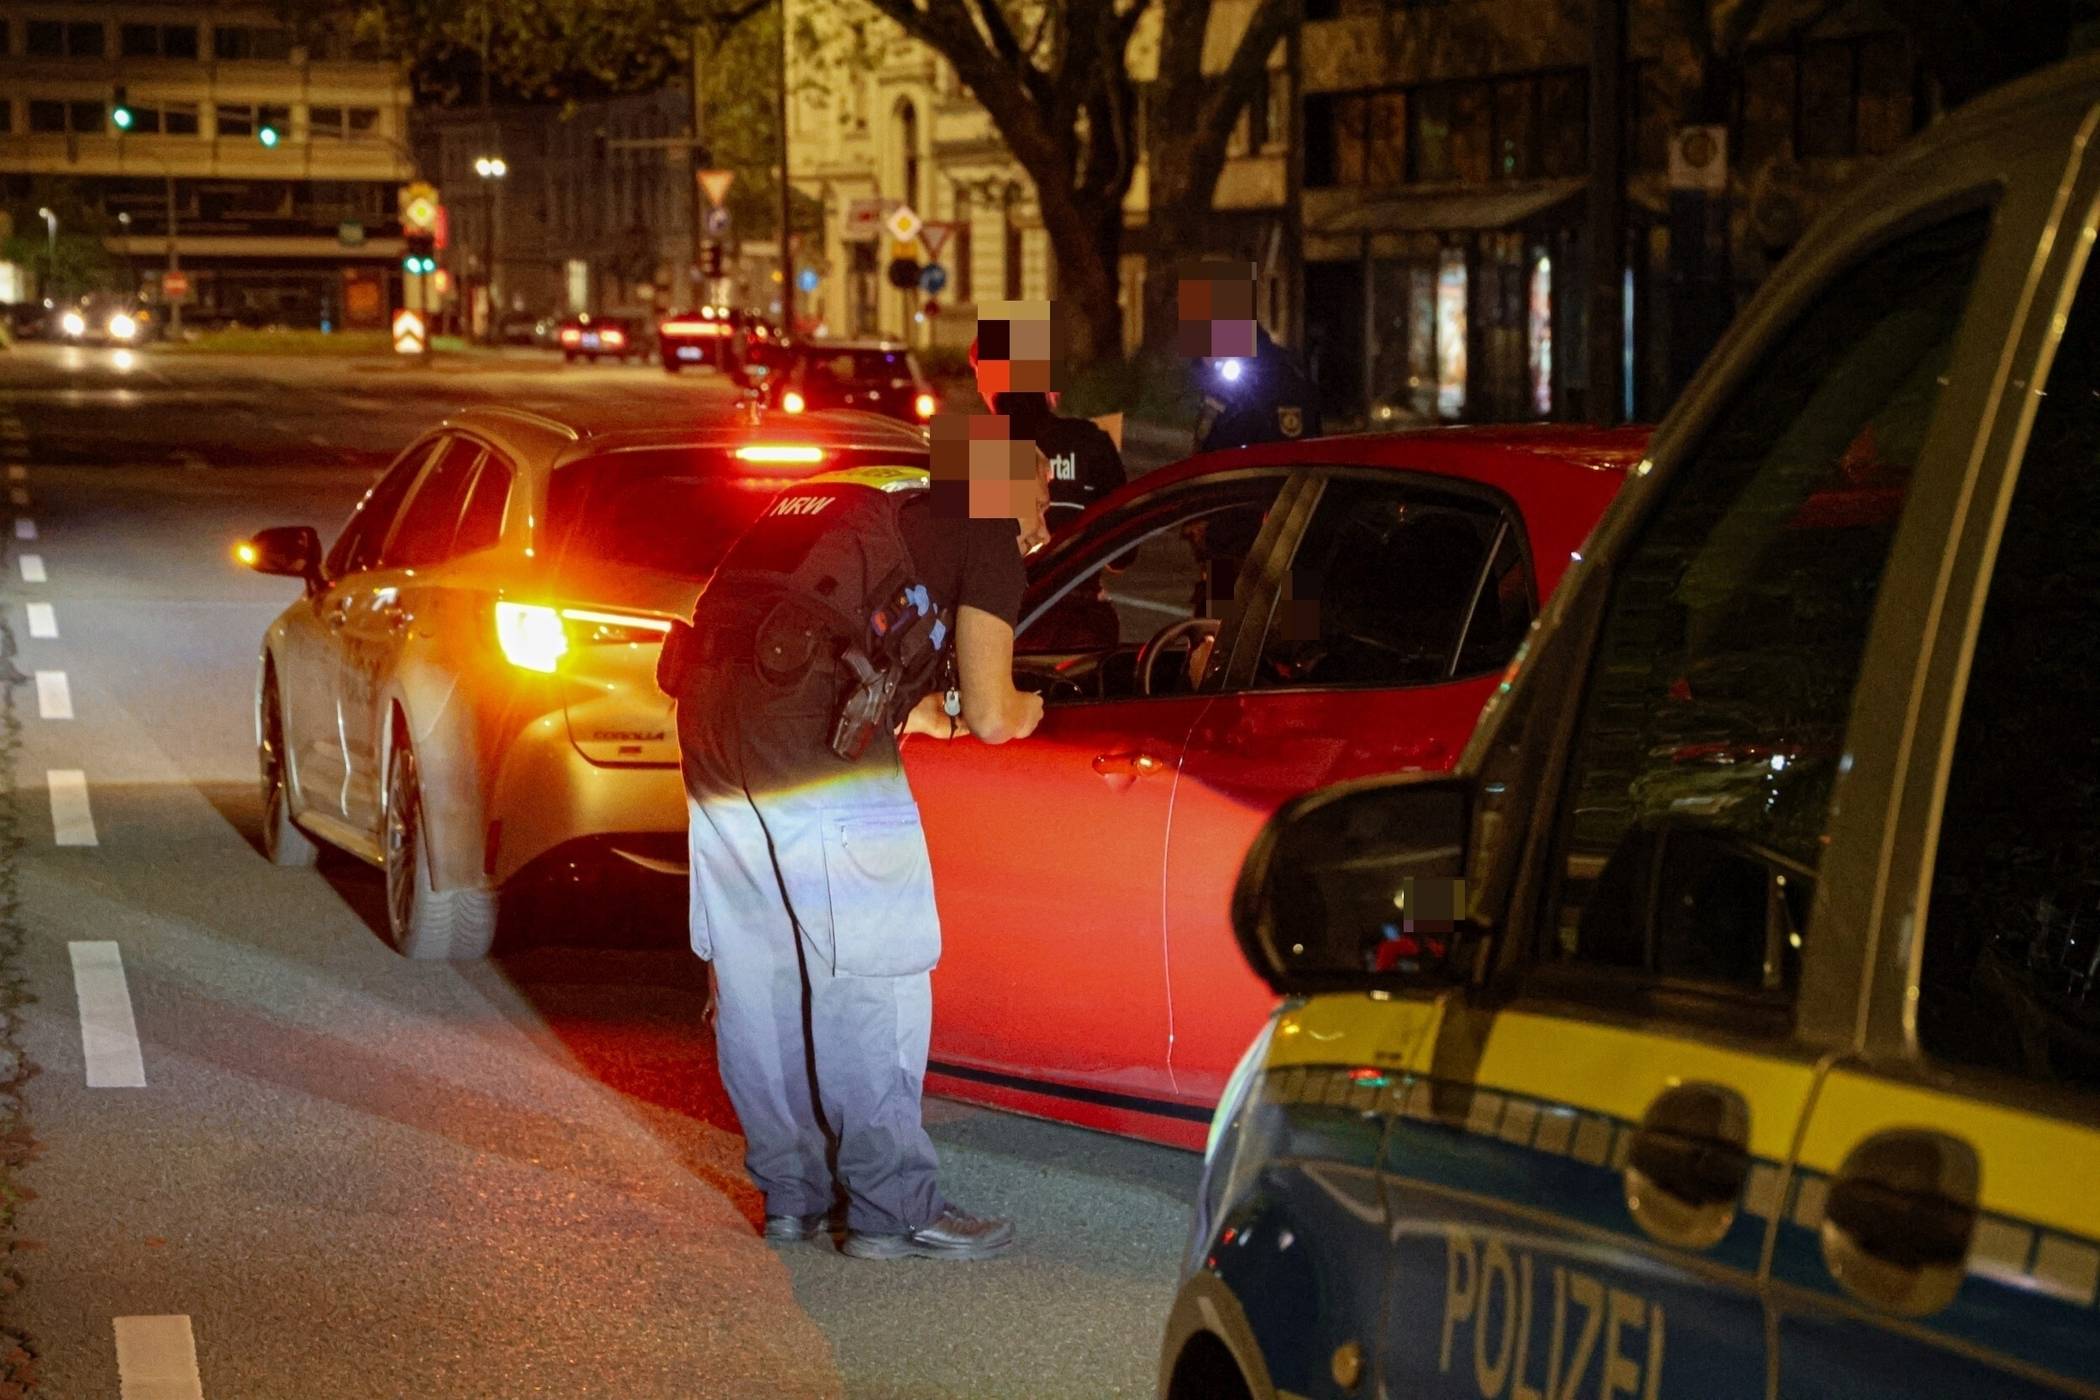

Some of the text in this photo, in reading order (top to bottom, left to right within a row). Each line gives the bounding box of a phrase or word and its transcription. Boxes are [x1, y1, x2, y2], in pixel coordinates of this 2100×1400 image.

[1049, 452, 1076, 480] rtal
[769, 496, 836, 517] NRW
[1438, 1228, 1667, 1400] POLIZEI
